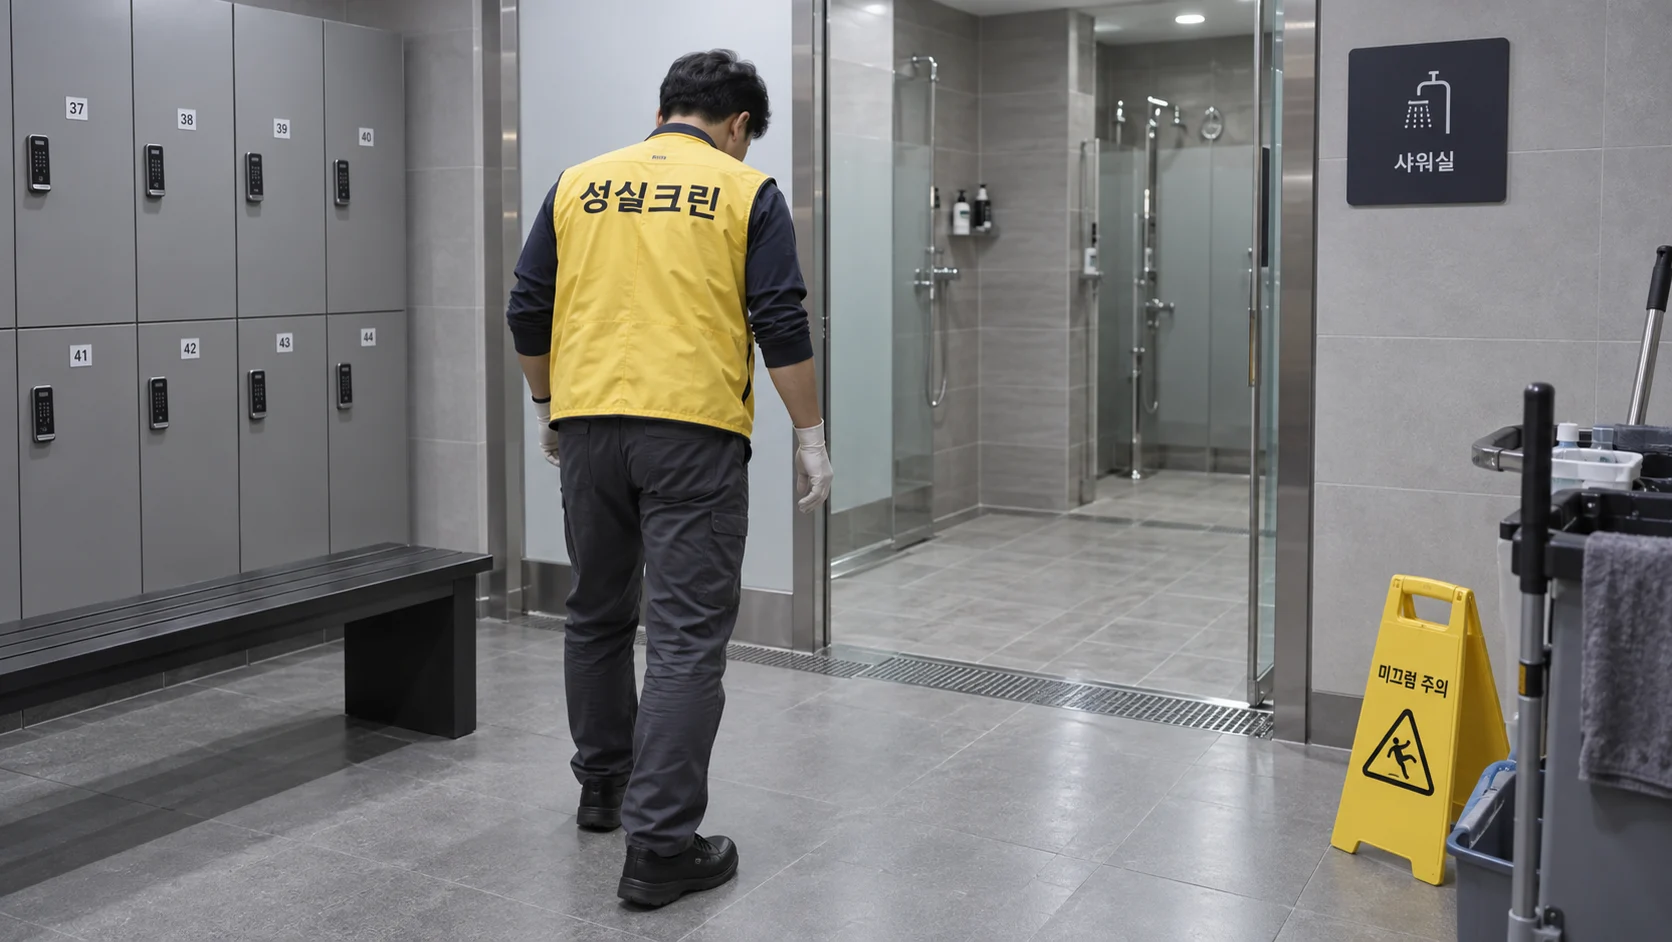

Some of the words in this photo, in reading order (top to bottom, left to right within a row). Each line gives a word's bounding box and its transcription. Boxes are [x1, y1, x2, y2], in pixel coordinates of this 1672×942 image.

[69, 102, 84, 115] 37
[180, 113, 194, 126] 38
[276, 122, 288, 135] 39
[361, 131, 372, 143] 40
[1394, 150, 1455, 173] 샤워실
[579, 179, 721, 221] 성실크린
[279, 337, 291, 349] 43
[363, 332, 374, 343] 44
[183, 342, 197, 355] 42
[74, 349, 88, 362] 41
[1378, 664, 1417, 690] 미끄럼
[1420, 674, 1449, 698] 주의
